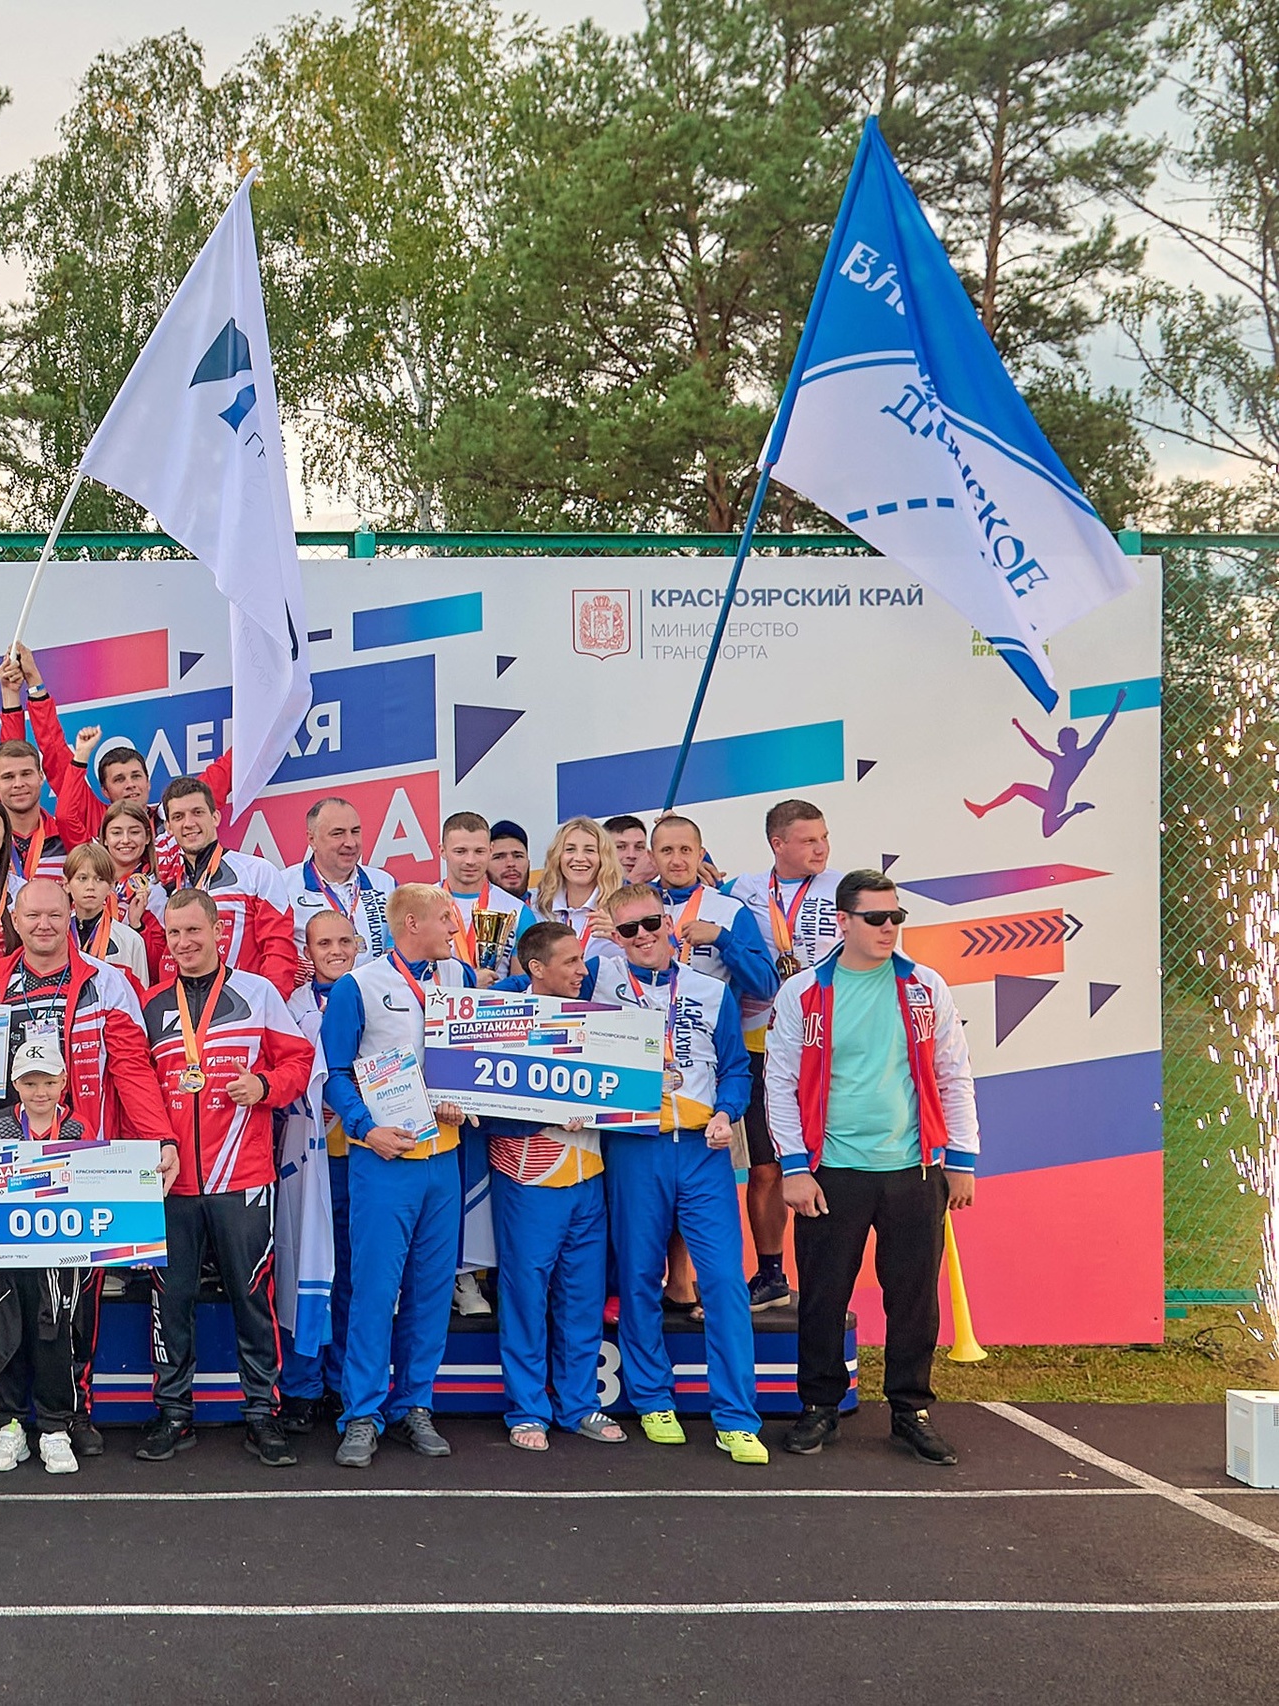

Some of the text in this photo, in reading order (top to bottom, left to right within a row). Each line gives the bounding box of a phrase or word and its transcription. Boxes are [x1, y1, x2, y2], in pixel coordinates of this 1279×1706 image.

[651, 584, 923, 607] КРАСНОЯРСКИЙ КРАЙ
[651, 621, 799, 638] МИНИСЕРСТВО
[361, 890, 383, 961] АЛАХТИНСКОЕ
[446, 996, 475, 1020] 18
[477, 1008, 524, 1018] ОТРАСЛЕВАЯ
[450, 1019, 534, 1034] СПАРТАКИАДА
[451, 1030, 527, 1040] МИНИСТЕРСТВА ТРАНСПОРТА
[363, 1060, 376, 1074] 18
[474, 1057, 518, 1089] 20
[376, 1083, 412, 1100] ДИПЛОМ
[152, 1289, 170, 1364] БРИЗ
[597, 1340, 621, 1408] 3
